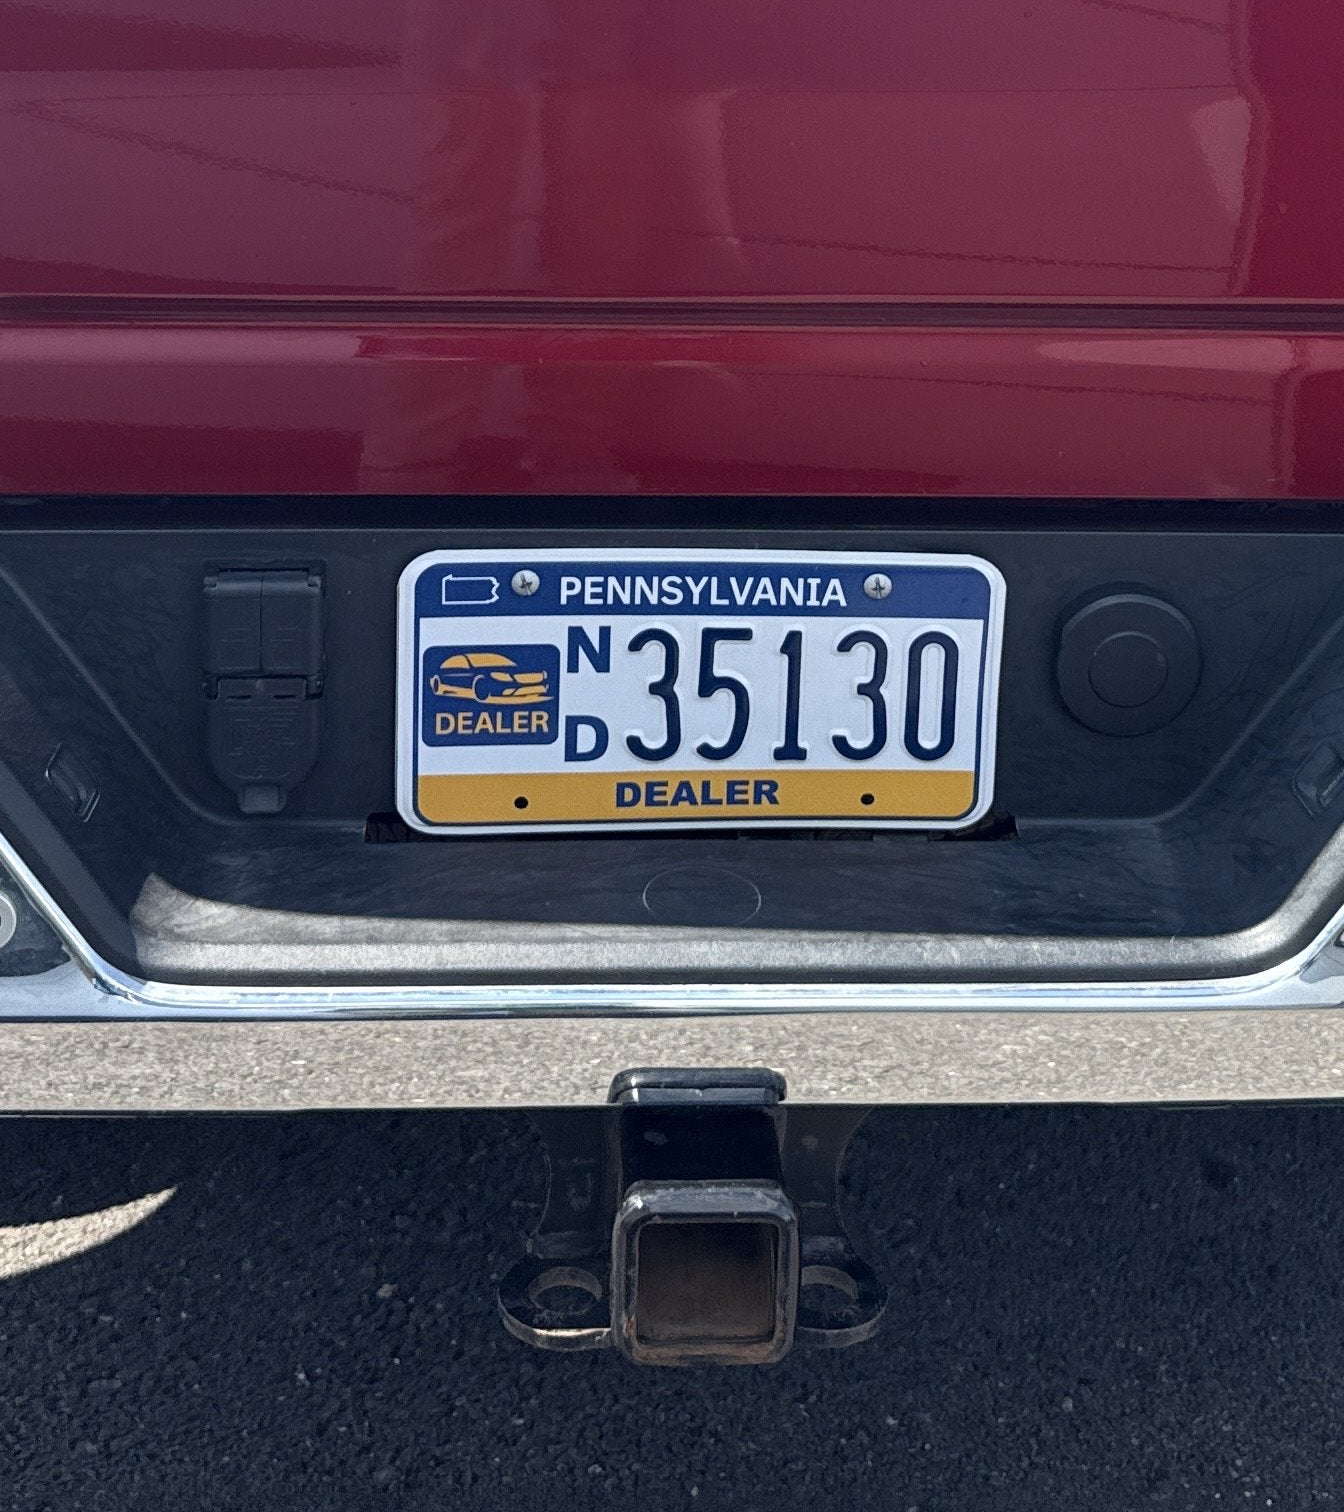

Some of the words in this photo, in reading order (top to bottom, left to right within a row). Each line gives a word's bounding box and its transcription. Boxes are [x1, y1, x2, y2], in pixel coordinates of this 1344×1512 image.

[559, 574, 848, 608] PENNSYLVANIA
[624, 626, 957, 762] 35130
[434, 711, 550, 736] DEALER
[615, 779, 780, 808] DEALER
